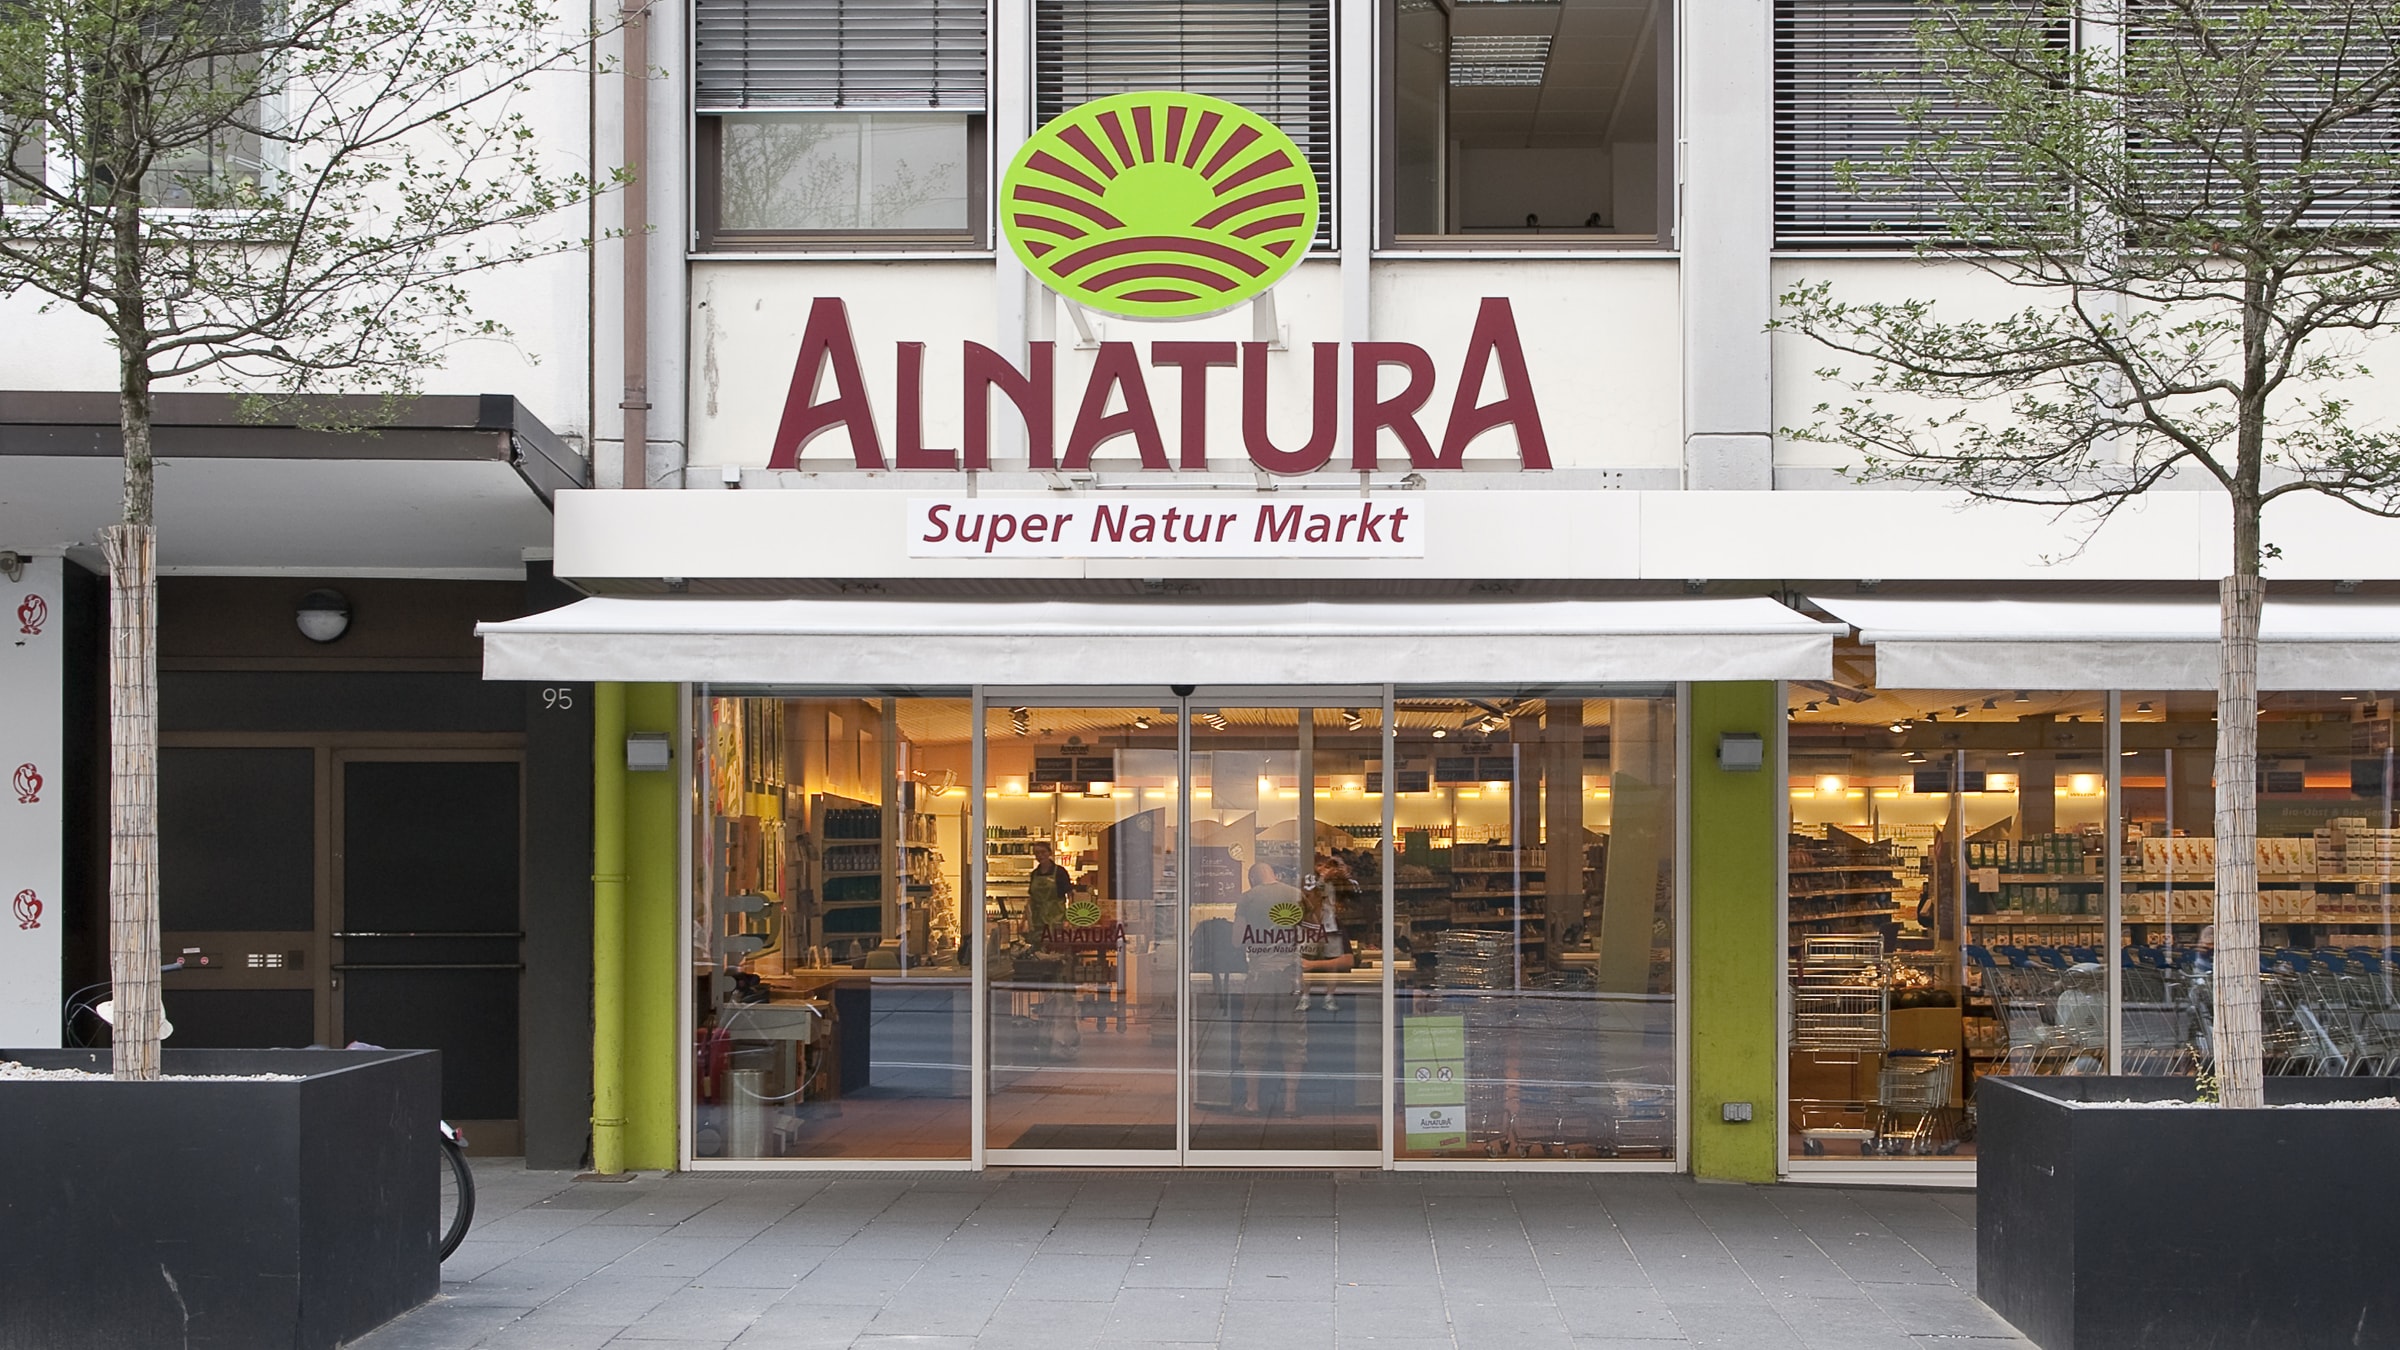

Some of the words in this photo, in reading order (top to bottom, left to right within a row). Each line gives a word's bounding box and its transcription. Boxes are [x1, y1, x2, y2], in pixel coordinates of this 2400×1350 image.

[767, 297, 1553, 475] ALNATURA
[923, 503, 1073, 553] Super
[1090, 504, 1237, 543] Natur
[1254, 502, 1409, 543] Markt
[542, 688, 573, 710] 95
[1040, 923, 1126, 943] ALNATURA
[1242, 924, 1329, 944] ALNATURA
[1246, 946, 1271, 955] Super
[1273, 945, 1298, 954] Natur
